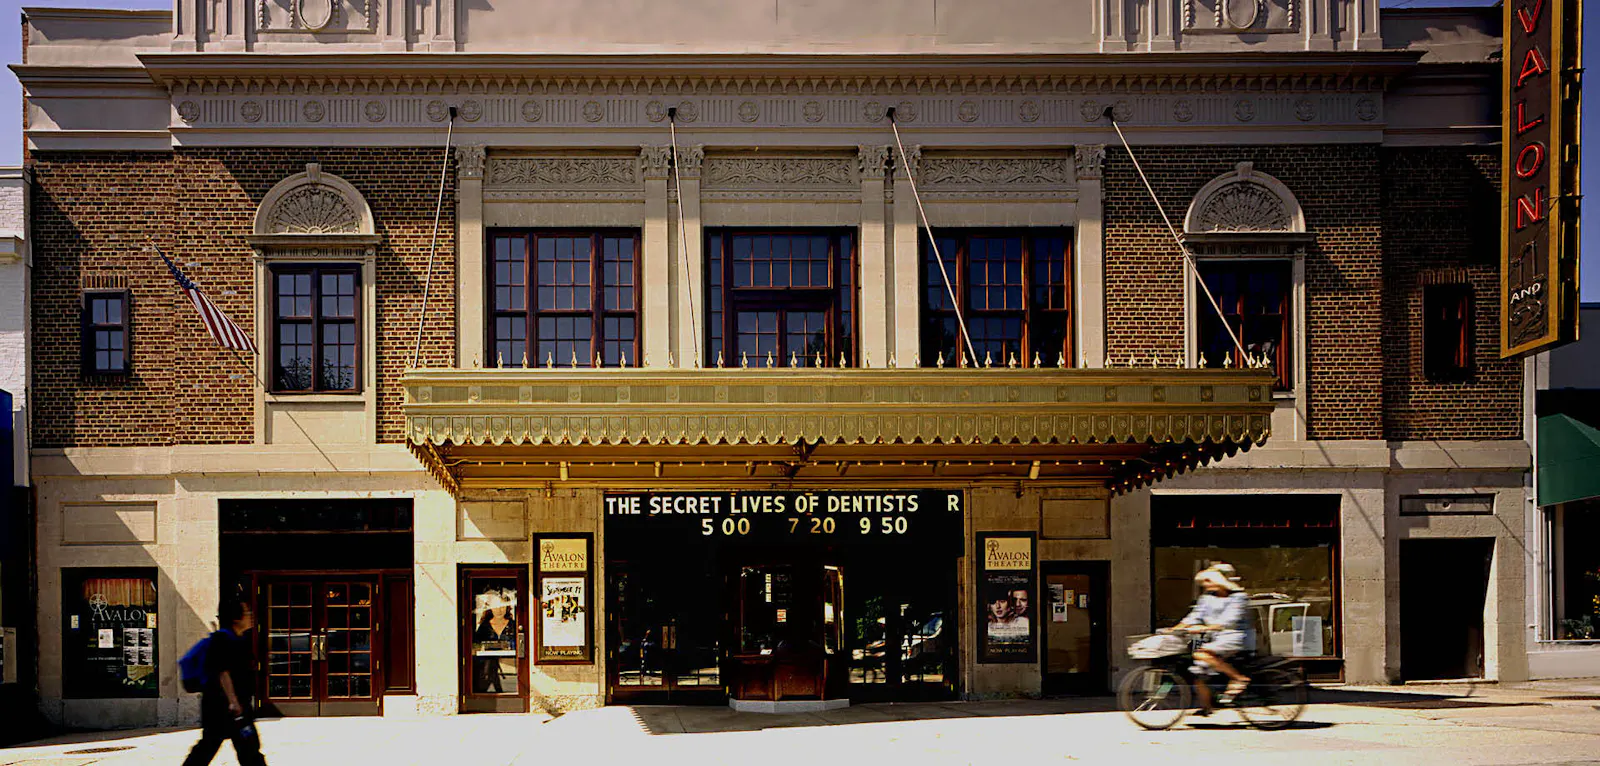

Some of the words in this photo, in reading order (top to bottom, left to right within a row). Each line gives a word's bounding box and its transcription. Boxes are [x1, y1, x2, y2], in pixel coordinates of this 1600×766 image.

[1516, 0, 1547, 229] VALON
[1510, 282, 1541, 304] AND
[606, 497, 640, 514] THE
[650, 496, 721, 514] SECRET
[730, 496, 785, 513] LIVES
[795, 496, 818, 513] OF
[827, 495, 918, 512] DENTISTS
[948, 495, 959, 511] R
[702, 518, 713, 535] 5
[722, 517, 750, 535] 00
[788, 517, 799, 533] 7
[811, 517, 836, 533] 20
[860, 517, 871, 534] 9
[882, 516, 908, 534] 50
[543, 550, 584, 562] AVALON
[988, 550, 1029, 560] AVALON
